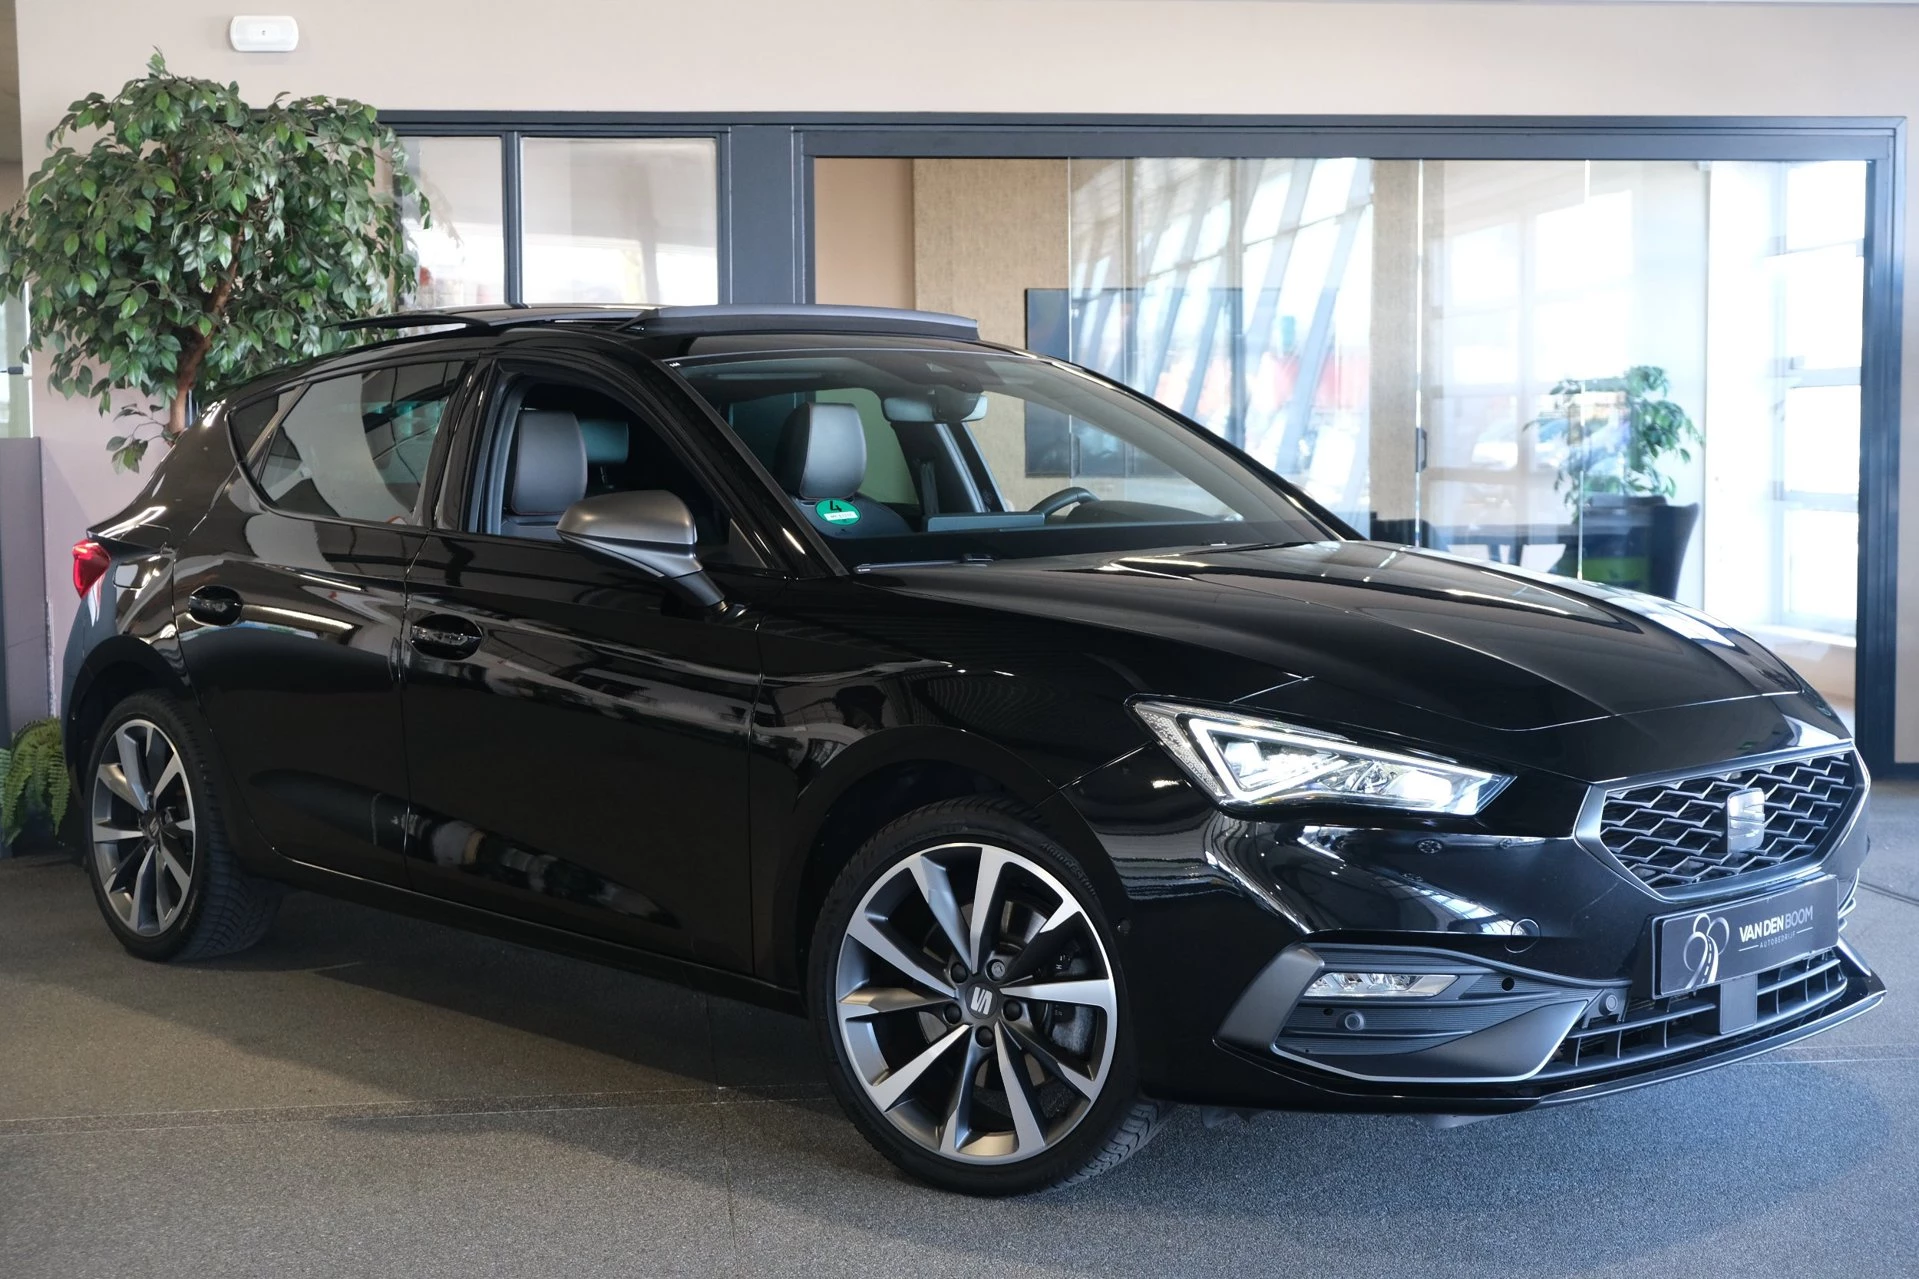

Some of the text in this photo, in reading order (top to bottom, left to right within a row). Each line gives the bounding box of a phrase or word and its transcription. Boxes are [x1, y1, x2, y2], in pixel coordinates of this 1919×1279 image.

[830, 500, 842, 512] 4
[1784, 905, 1814, 930] BOOM
[1760, 930, 1796, 949] AUTOBEDRIJF
